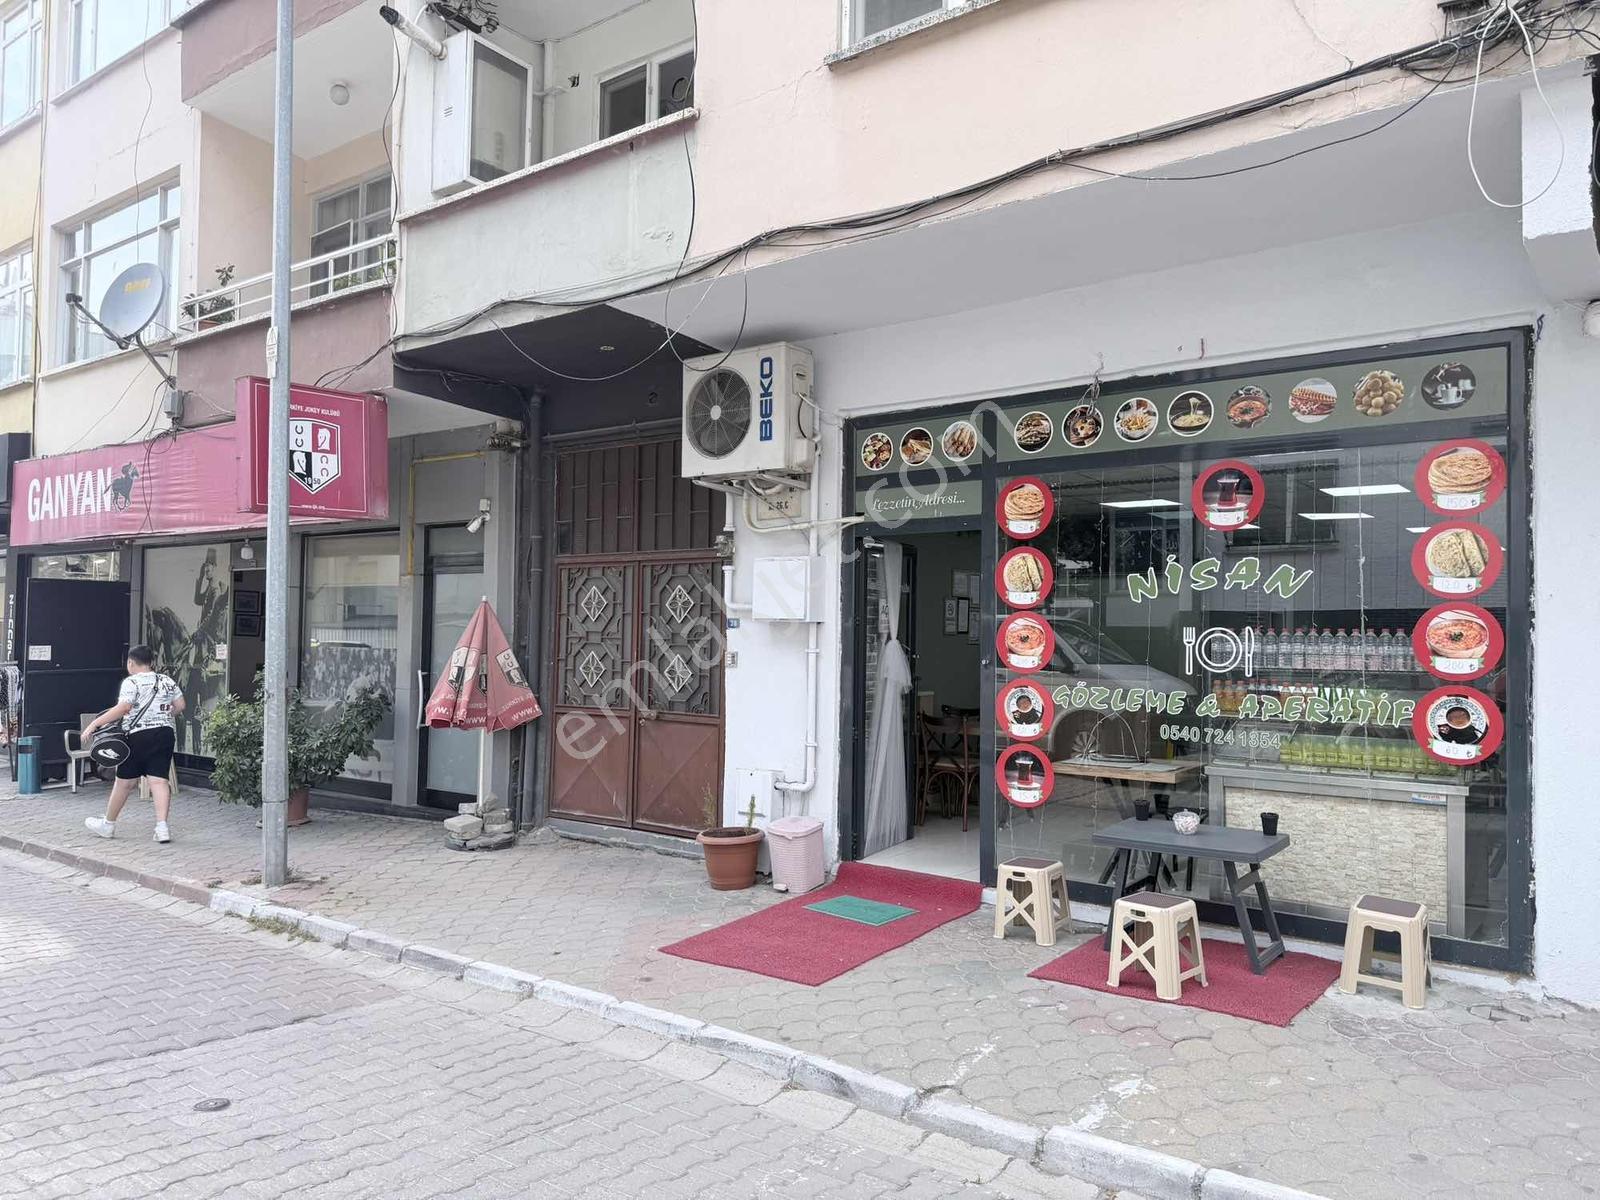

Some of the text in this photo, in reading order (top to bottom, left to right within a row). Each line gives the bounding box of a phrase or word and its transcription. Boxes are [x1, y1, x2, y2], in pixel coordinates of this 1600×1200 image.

[760, 356, 773, 442] BEKO
[27, 467, 113, 522] GANYAN
[1127, 554, 1313, 604] NİSAN
[1052, 681, 1416, 729] GÖZLEME & APERATİF
[1159, 724, 1200, 743] 0540
[1203, 727, 1235, 746] 724
